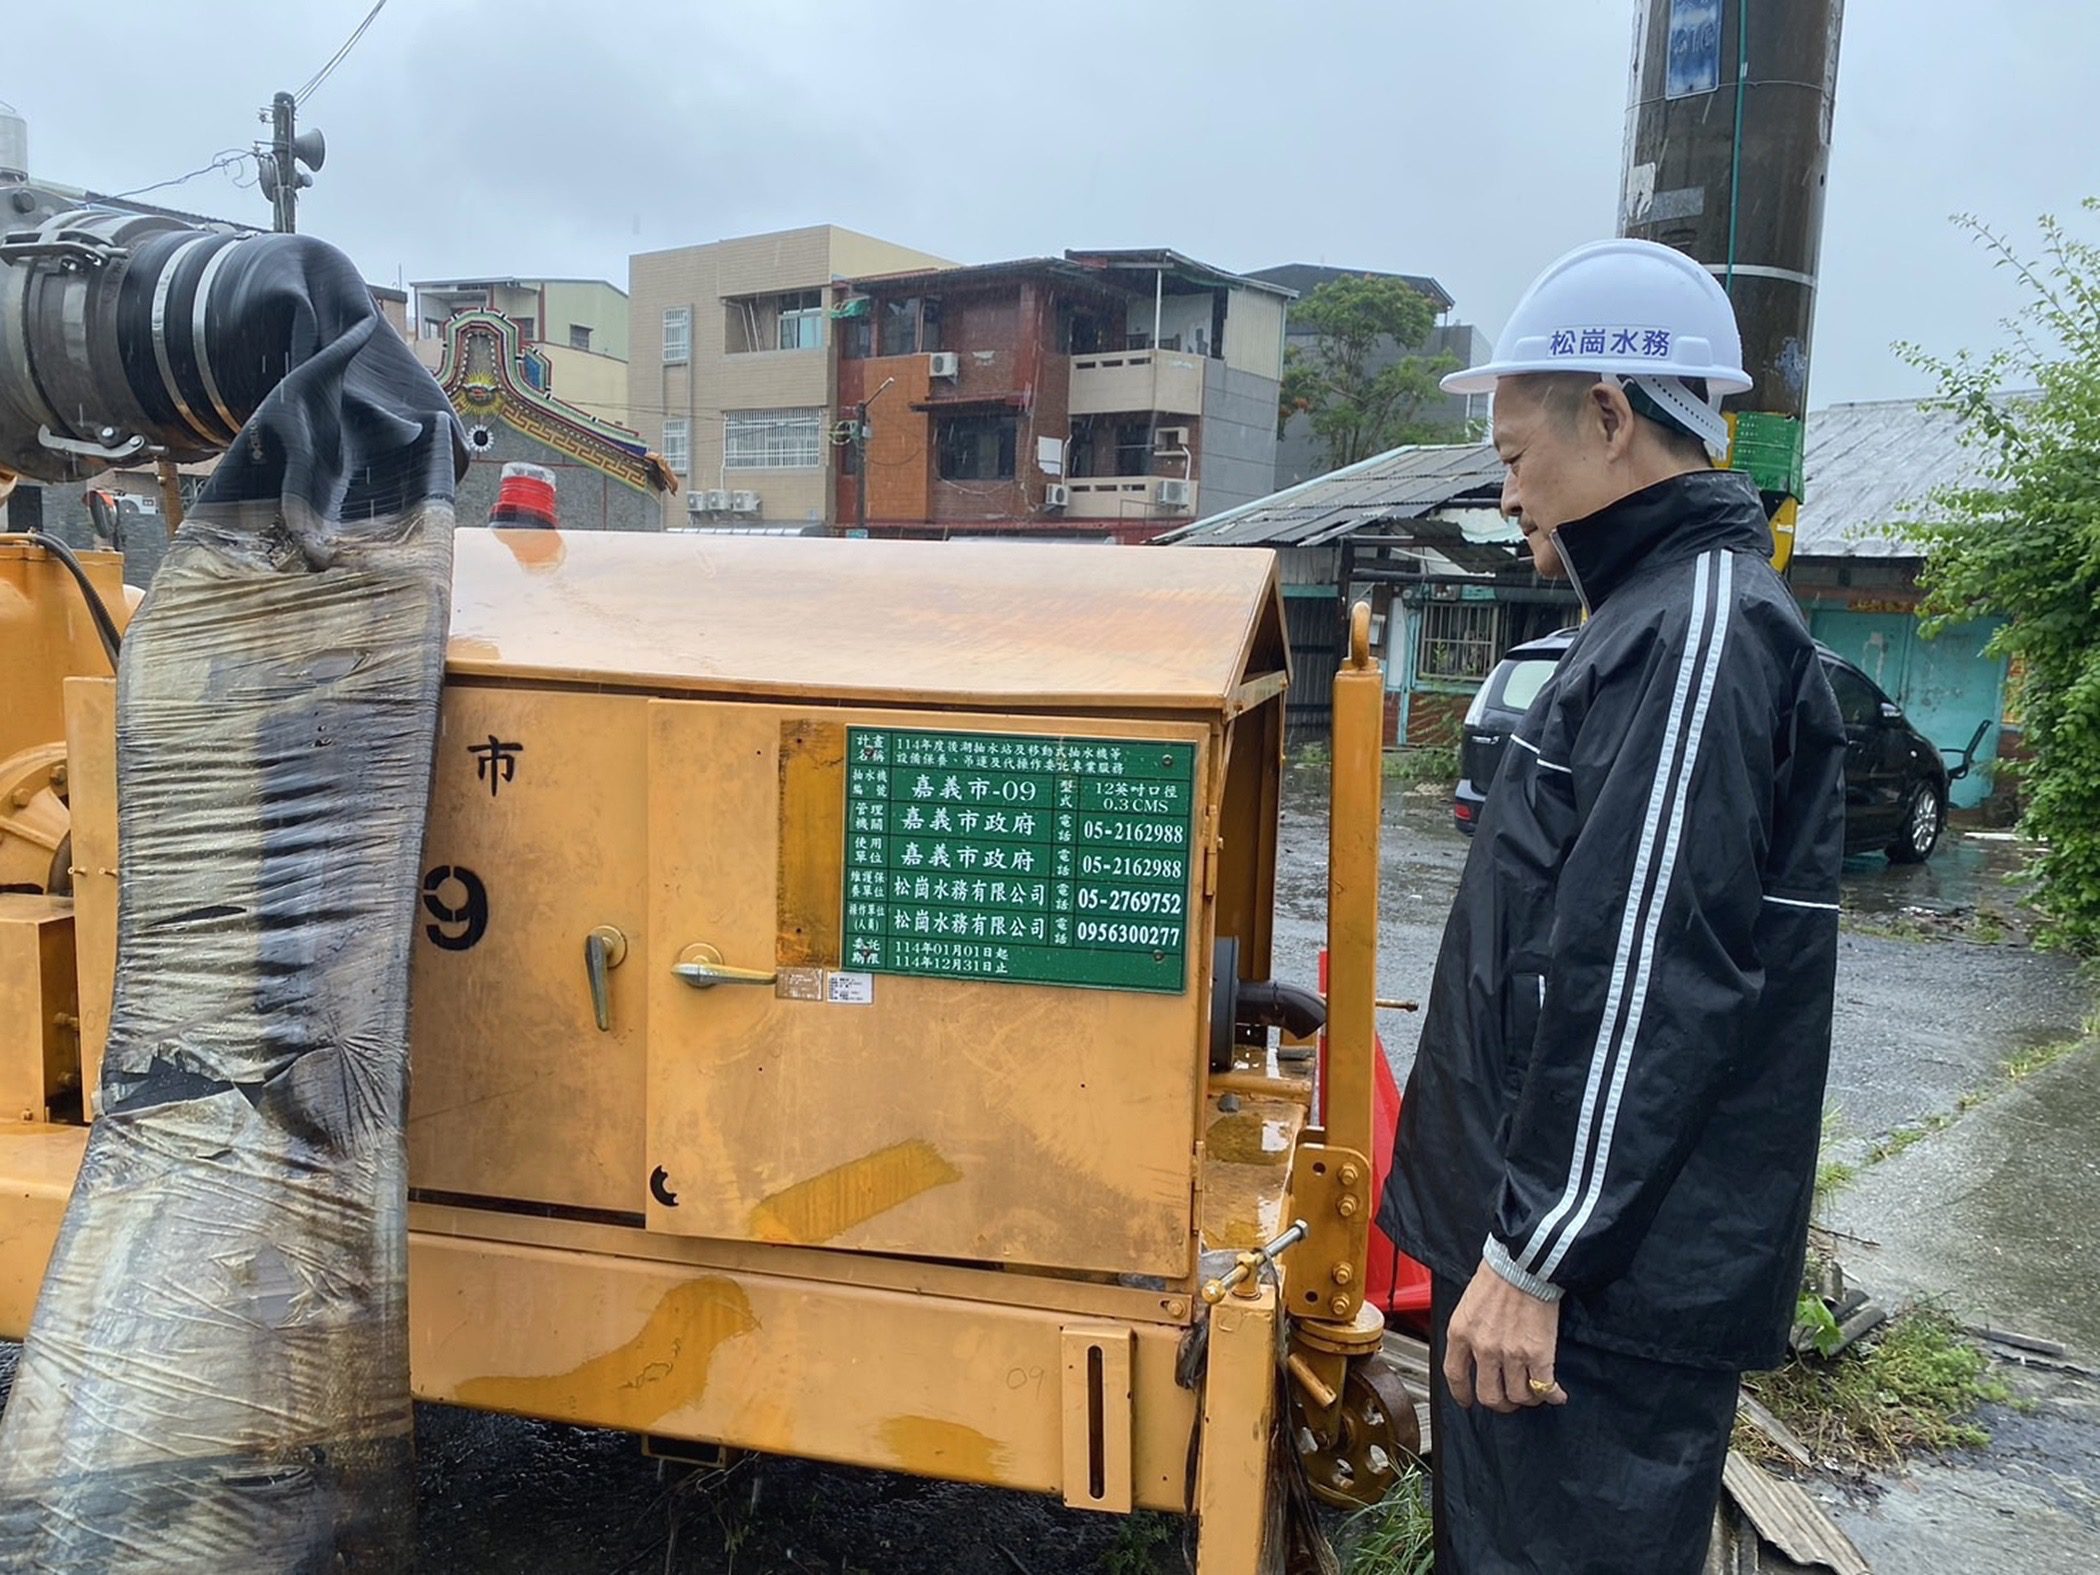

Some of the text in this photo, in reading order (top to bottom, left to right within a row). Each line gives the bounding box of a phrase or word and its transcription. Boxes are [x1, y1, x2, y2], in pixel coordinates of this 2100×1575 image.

[1550, 328, 1670, 357] 松崗水務
[467, 735, 523, 797] 市
[853, 769, 887, 783] 抽水機
[912, 774, 1036, 801] 嘉義市-09
[1096, 782, 1177, 799] 12英吋口徑
[855, 802, 883, 816] 管理
[901, 805, 1036, 836] 嘉義市政府
[855, 817, 883, 831] 機關
[1084, 820, 1183, 843] 05-2162988
[855, 836, 882, 850] 使用
[855, 850, 883, 864] 單位
[901, 841, 1035, 872] 嘉義市政府
[1083, 855, 1182, 878] 05-2162988
[894, 875, 1045, 906] 松崗水務有限公司
[1078, 888, 1181, 914] 05-2769752
[423, 865, 488, 951] 9
[894, 908, 1045, 940] 松崗水務有限公司
[1077, 922, 1180, 946] 0956300277
[896, 941, 1009, 960] 114年01月01日起
[896, 955, 1009, 974] 114年12月31日止
